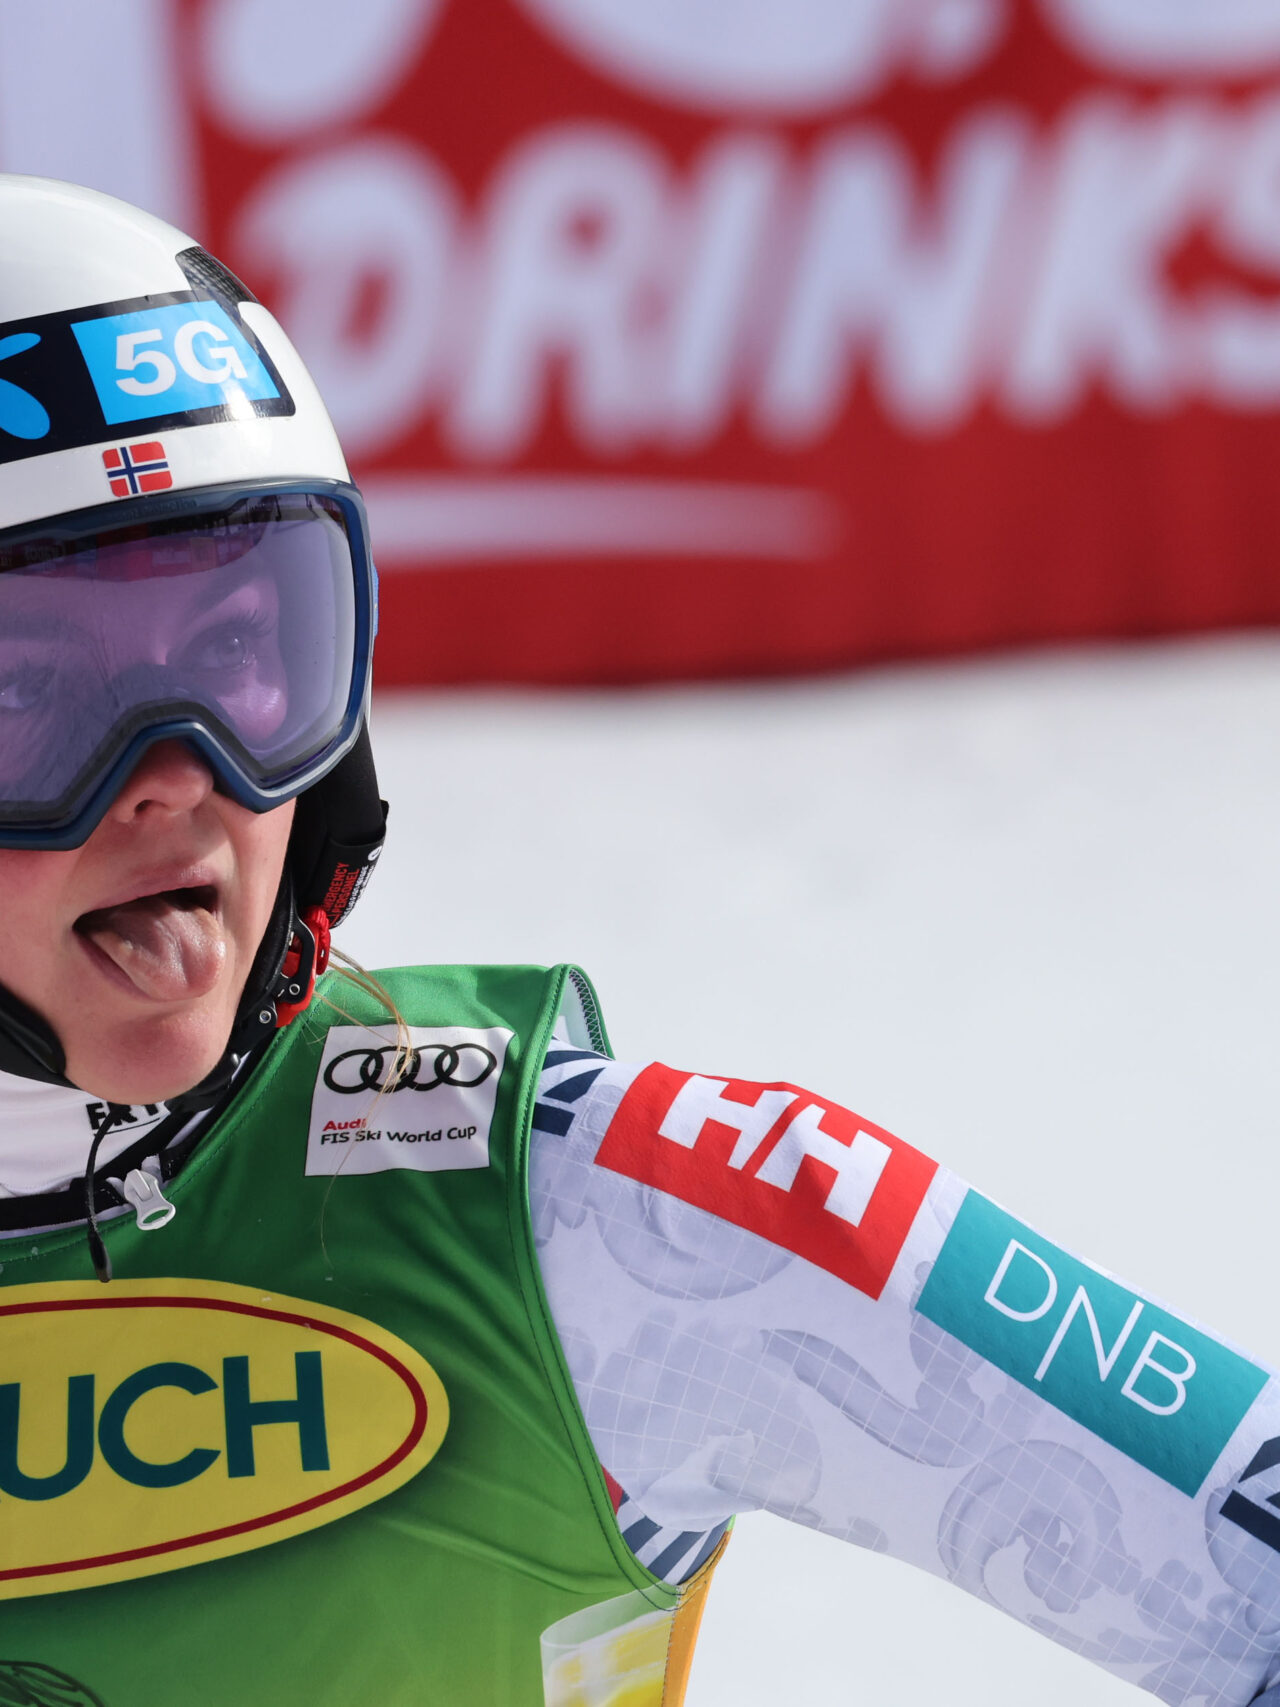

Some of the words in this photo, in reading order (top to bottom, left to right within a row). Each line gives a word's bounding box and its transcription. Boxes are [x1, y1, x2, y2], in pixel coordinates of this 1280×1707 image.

[115, 319, 249, 397] 5G
[321, 1131, 350, 1145] FIS
[355, 1130, 381, 1142] Ski
[386, 1130, 442, 1143] World
[447, 1125, 477, 1140] Cup
[323, 1118, 367, 1132] Audi
[983, 1238, 1197, 1416] DNB
